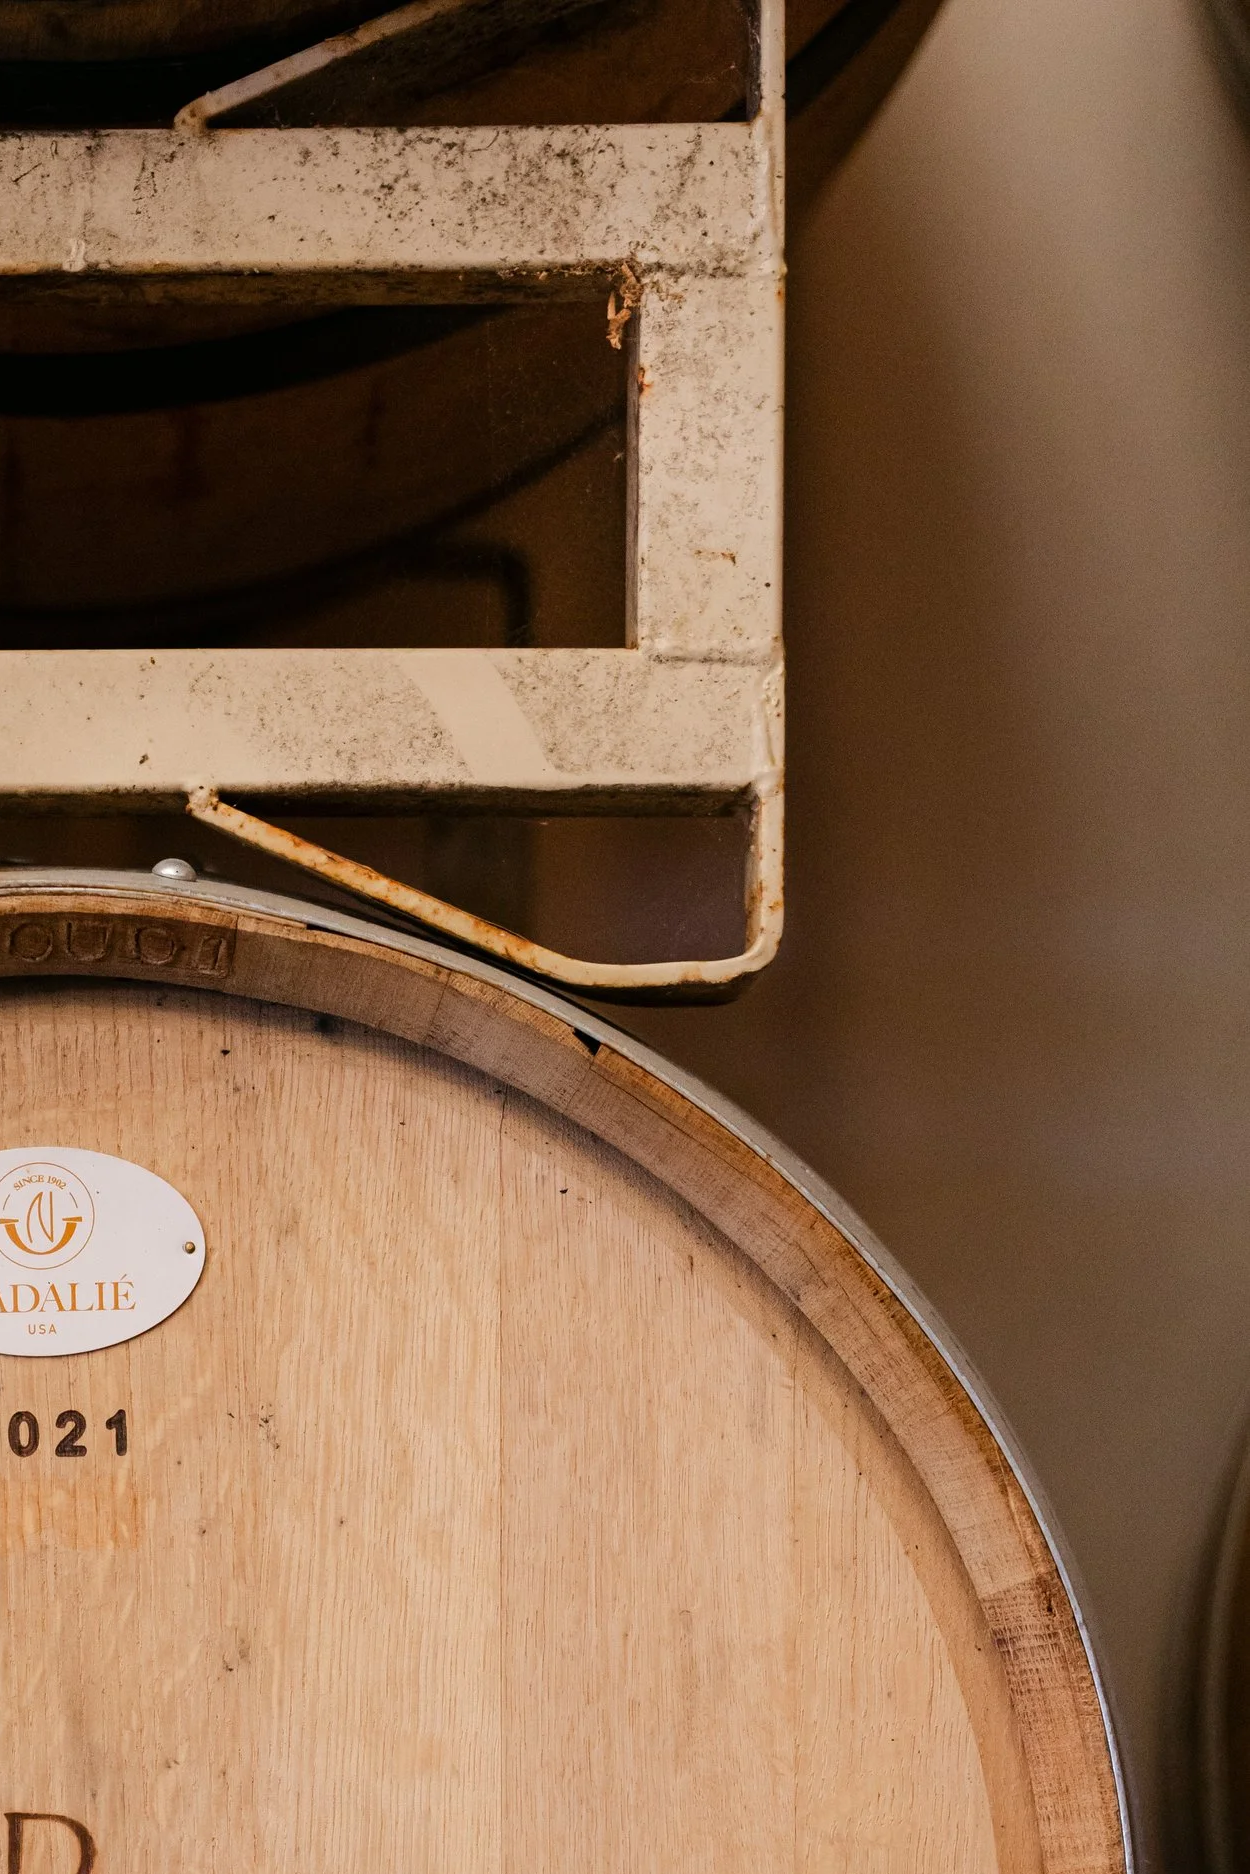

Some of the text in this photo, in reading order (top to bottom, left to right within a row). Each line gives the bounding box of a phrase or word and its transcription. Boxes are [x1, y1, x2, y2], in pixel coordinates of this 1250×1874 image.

[13, 1174, 67, 1191] SINCE 1902
[27, 1324, 57, 1335] USA
